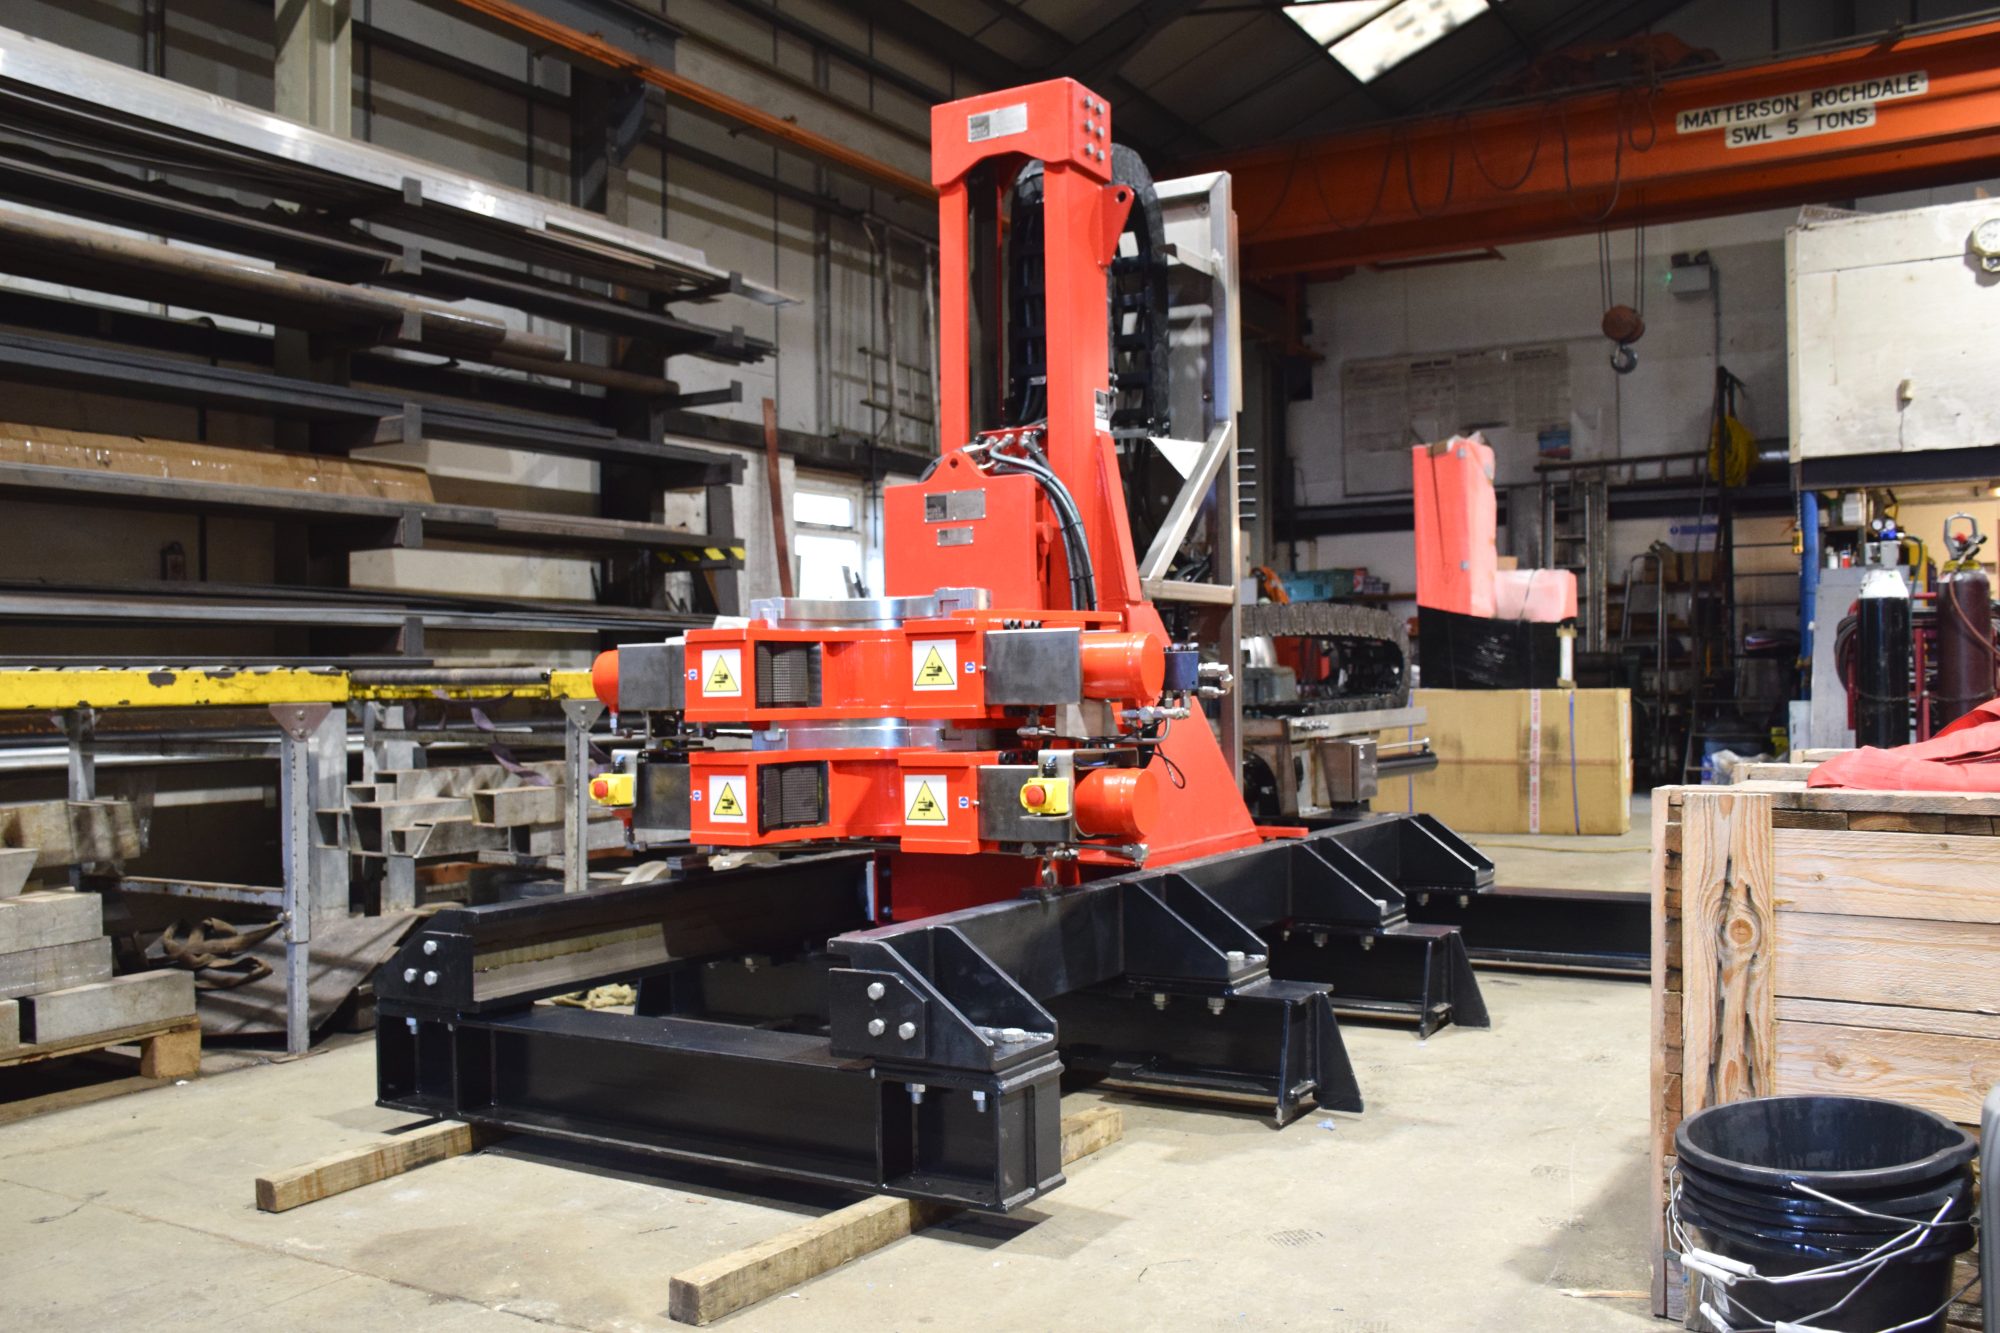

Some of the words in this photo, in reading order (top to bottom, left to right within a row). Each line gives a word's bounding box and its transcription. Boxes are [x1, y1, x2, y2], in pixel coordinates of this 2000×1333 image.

[1683, 95, 1799, 130] MATTERSON
[1811, 73, 1919, 108] ROCHDALE
[1732, 122, 1772, 144] SWL
[1786, 118, 1799, 135] 5
[1814, 106, 1868, 131] TONS
